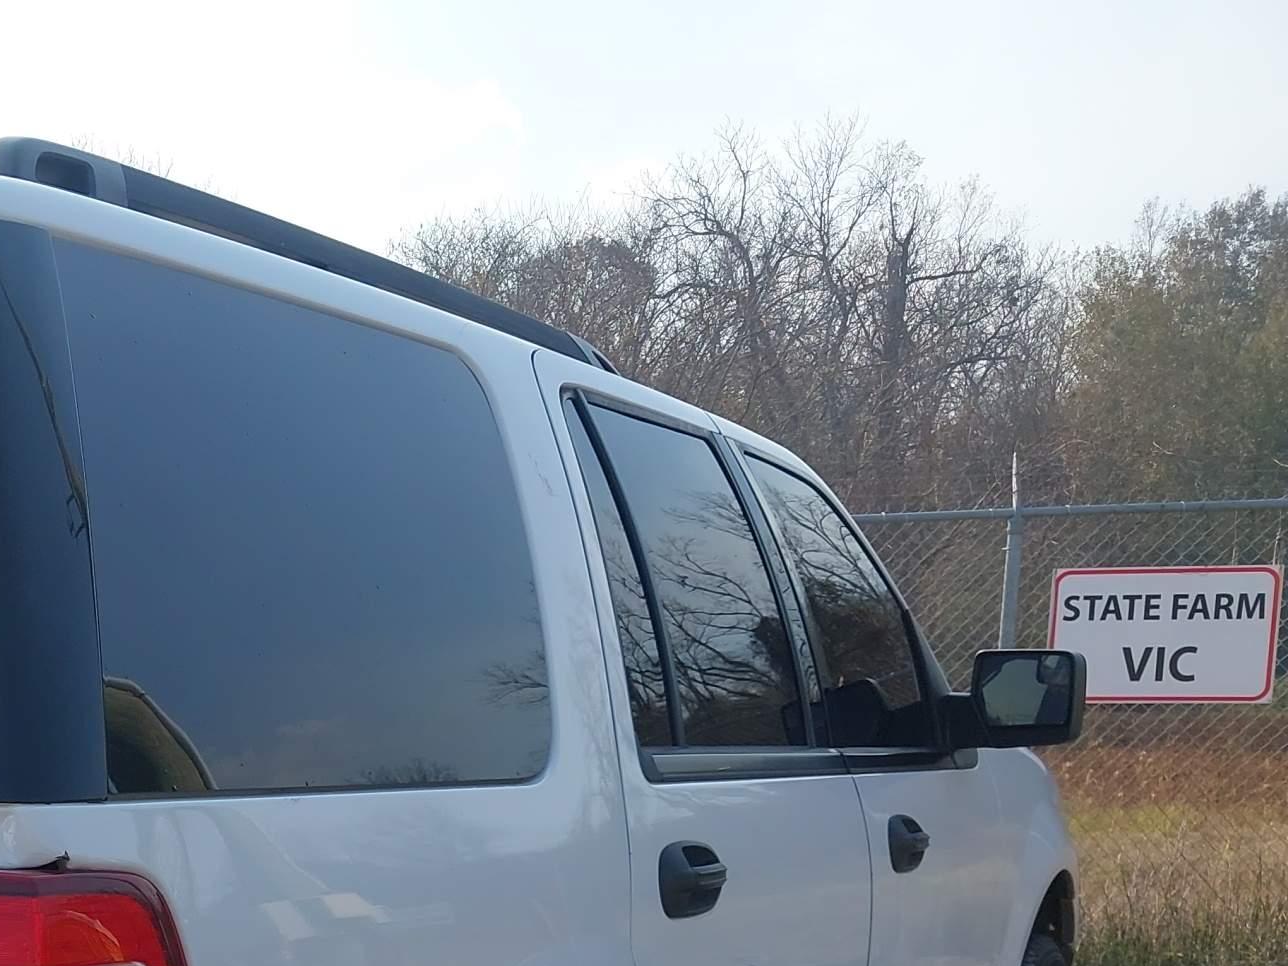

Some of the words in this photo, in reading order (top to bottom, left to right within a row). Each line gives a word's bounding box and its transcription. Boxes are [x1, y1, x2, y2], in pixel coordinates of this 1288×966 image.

[1063, 594, 1161, 621] STATE
[1171, 592, 1266, 620] FARM
[1123, 646, 1197, 682] VIC
